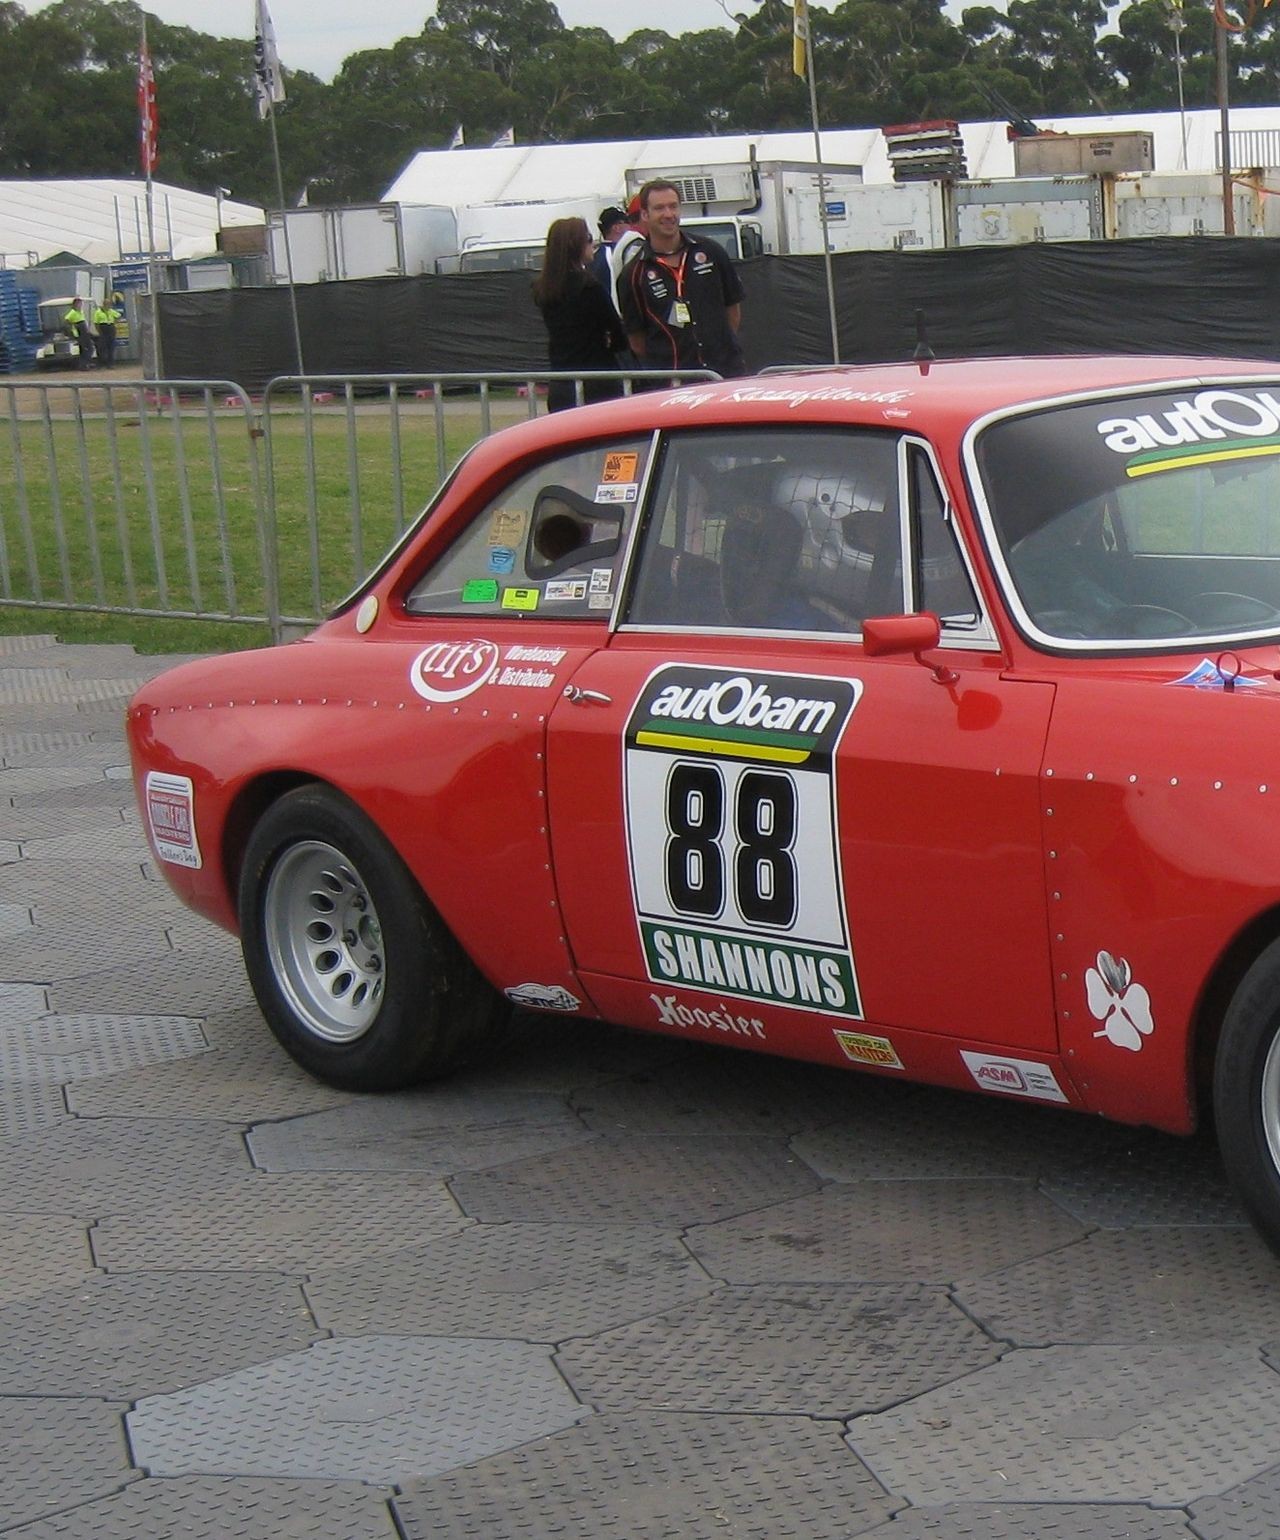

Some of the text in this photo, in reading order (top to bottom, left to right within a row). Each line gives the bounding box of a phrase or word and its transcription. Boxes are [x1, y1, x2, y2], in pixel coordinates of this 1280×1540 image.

[488, 667, 499, 685] &
[664, 759, 799, 931] 88
[653, 930, 846, 1007] SHANNONS
[650, 994, 767, 1039] Hoosier
